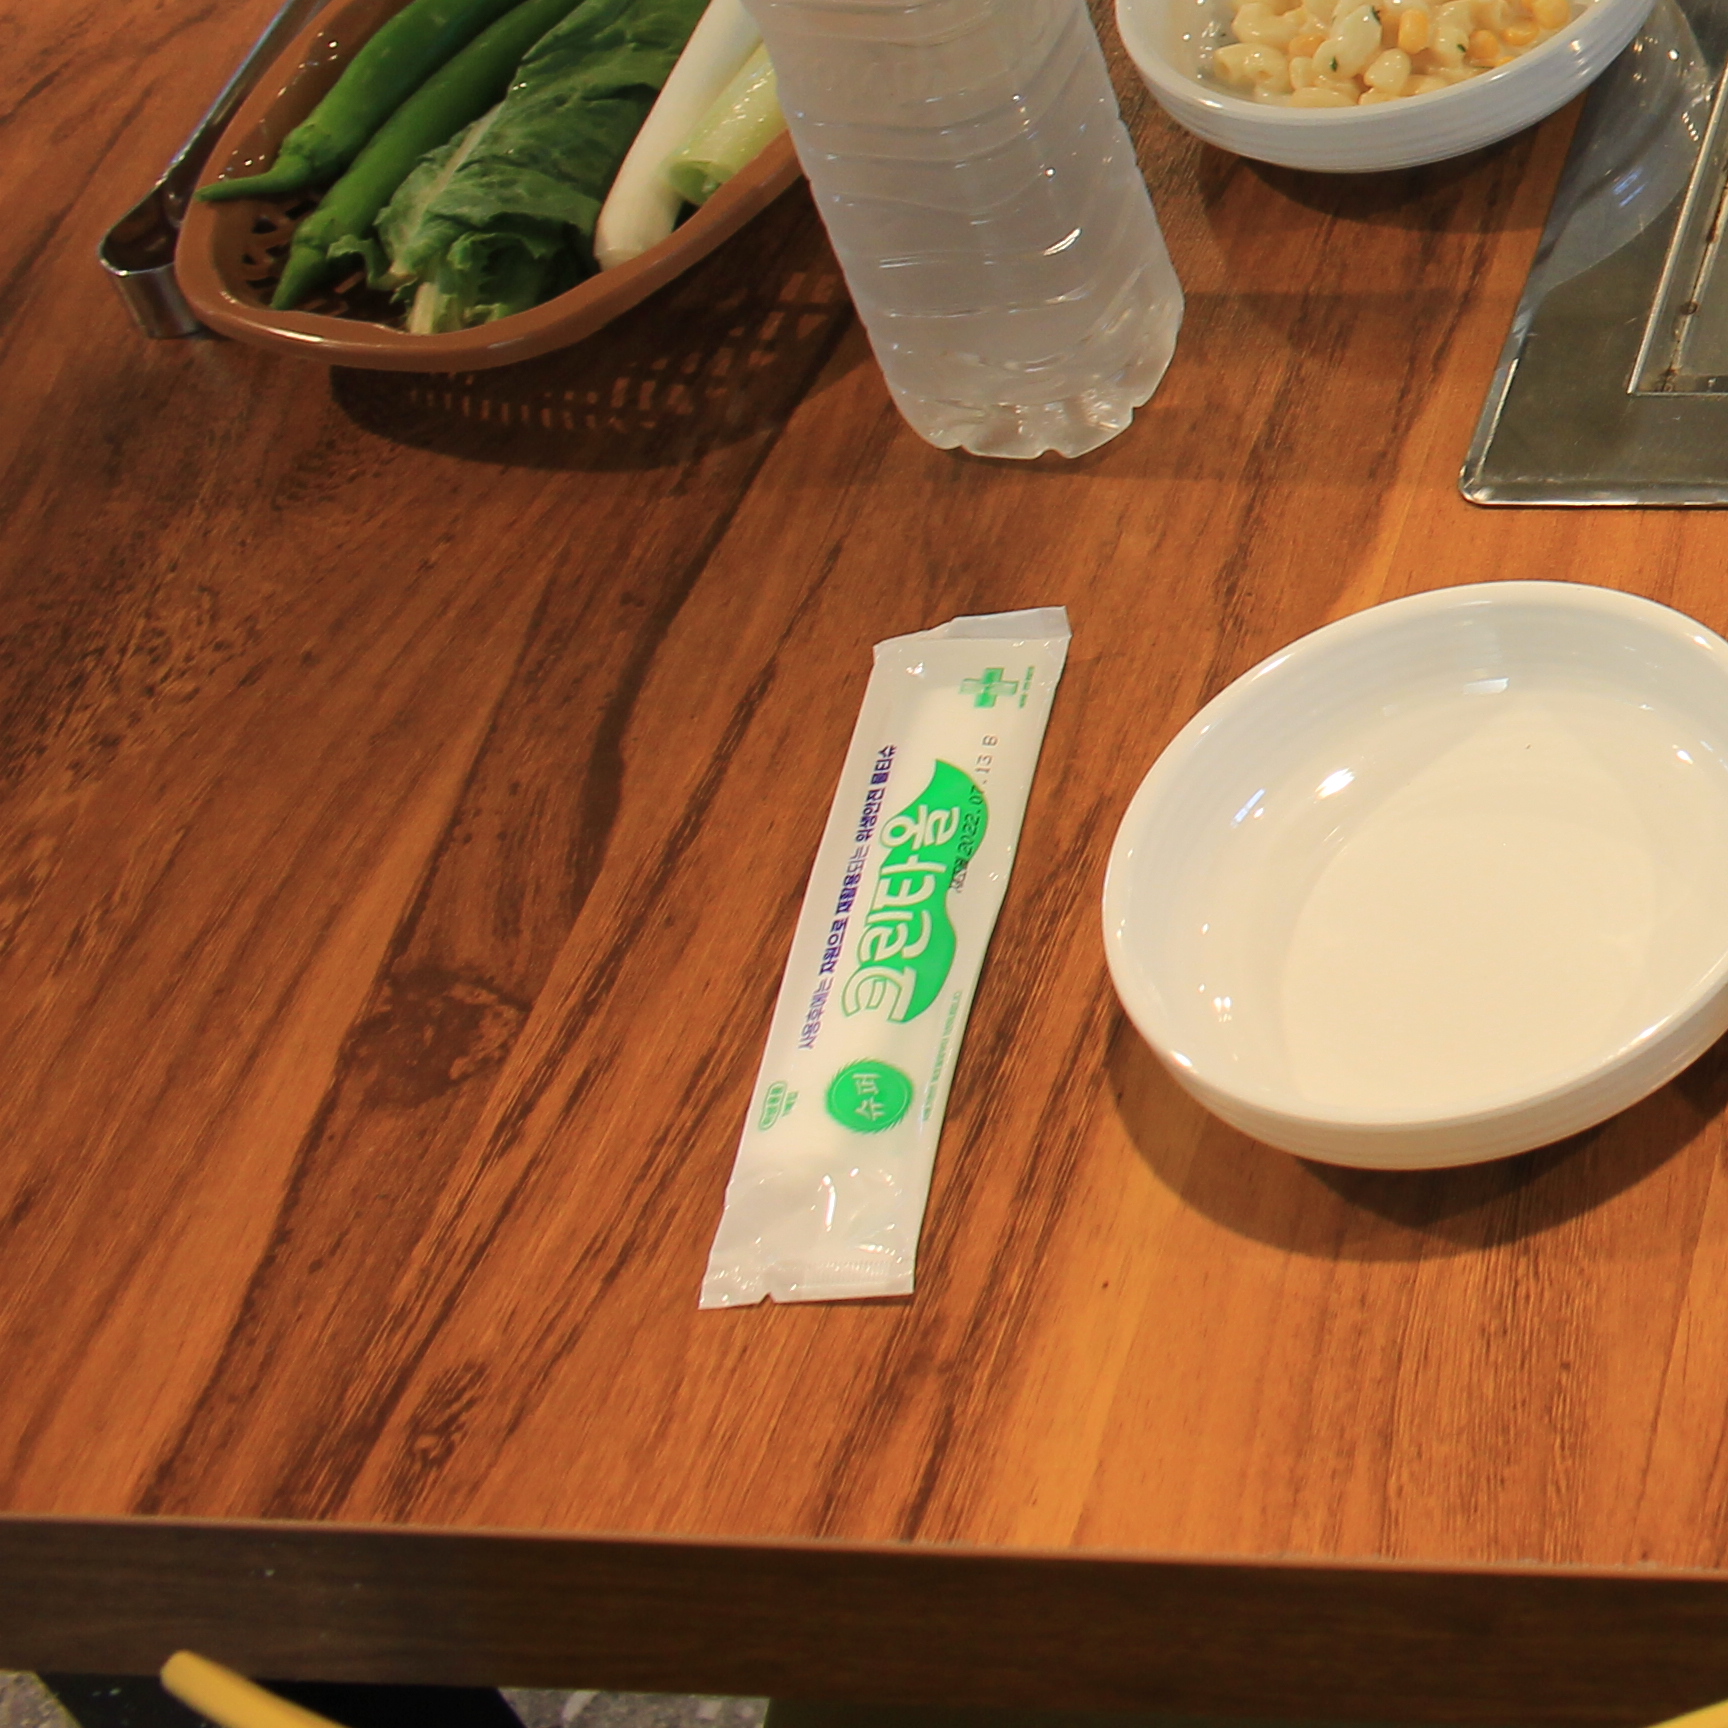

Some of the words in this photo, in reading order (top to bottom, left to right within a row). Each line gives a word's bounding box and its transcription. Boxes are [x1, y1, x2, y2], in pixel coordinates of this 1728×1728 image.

[870, 744, 897, 785] 물티슈
[855, 787, 886, 843] 위생안전
[956, 754, 993, 856] 2022.07.13
[835, 843, 872, 916] 재활용되는
[818, 915, 850, 977] 자원으로
[841, 803, 961, 1024] 크린타올
[798, 976, 835, 1050] 사용후에는
[852, 1072, 886, 1122] 슈퍼
